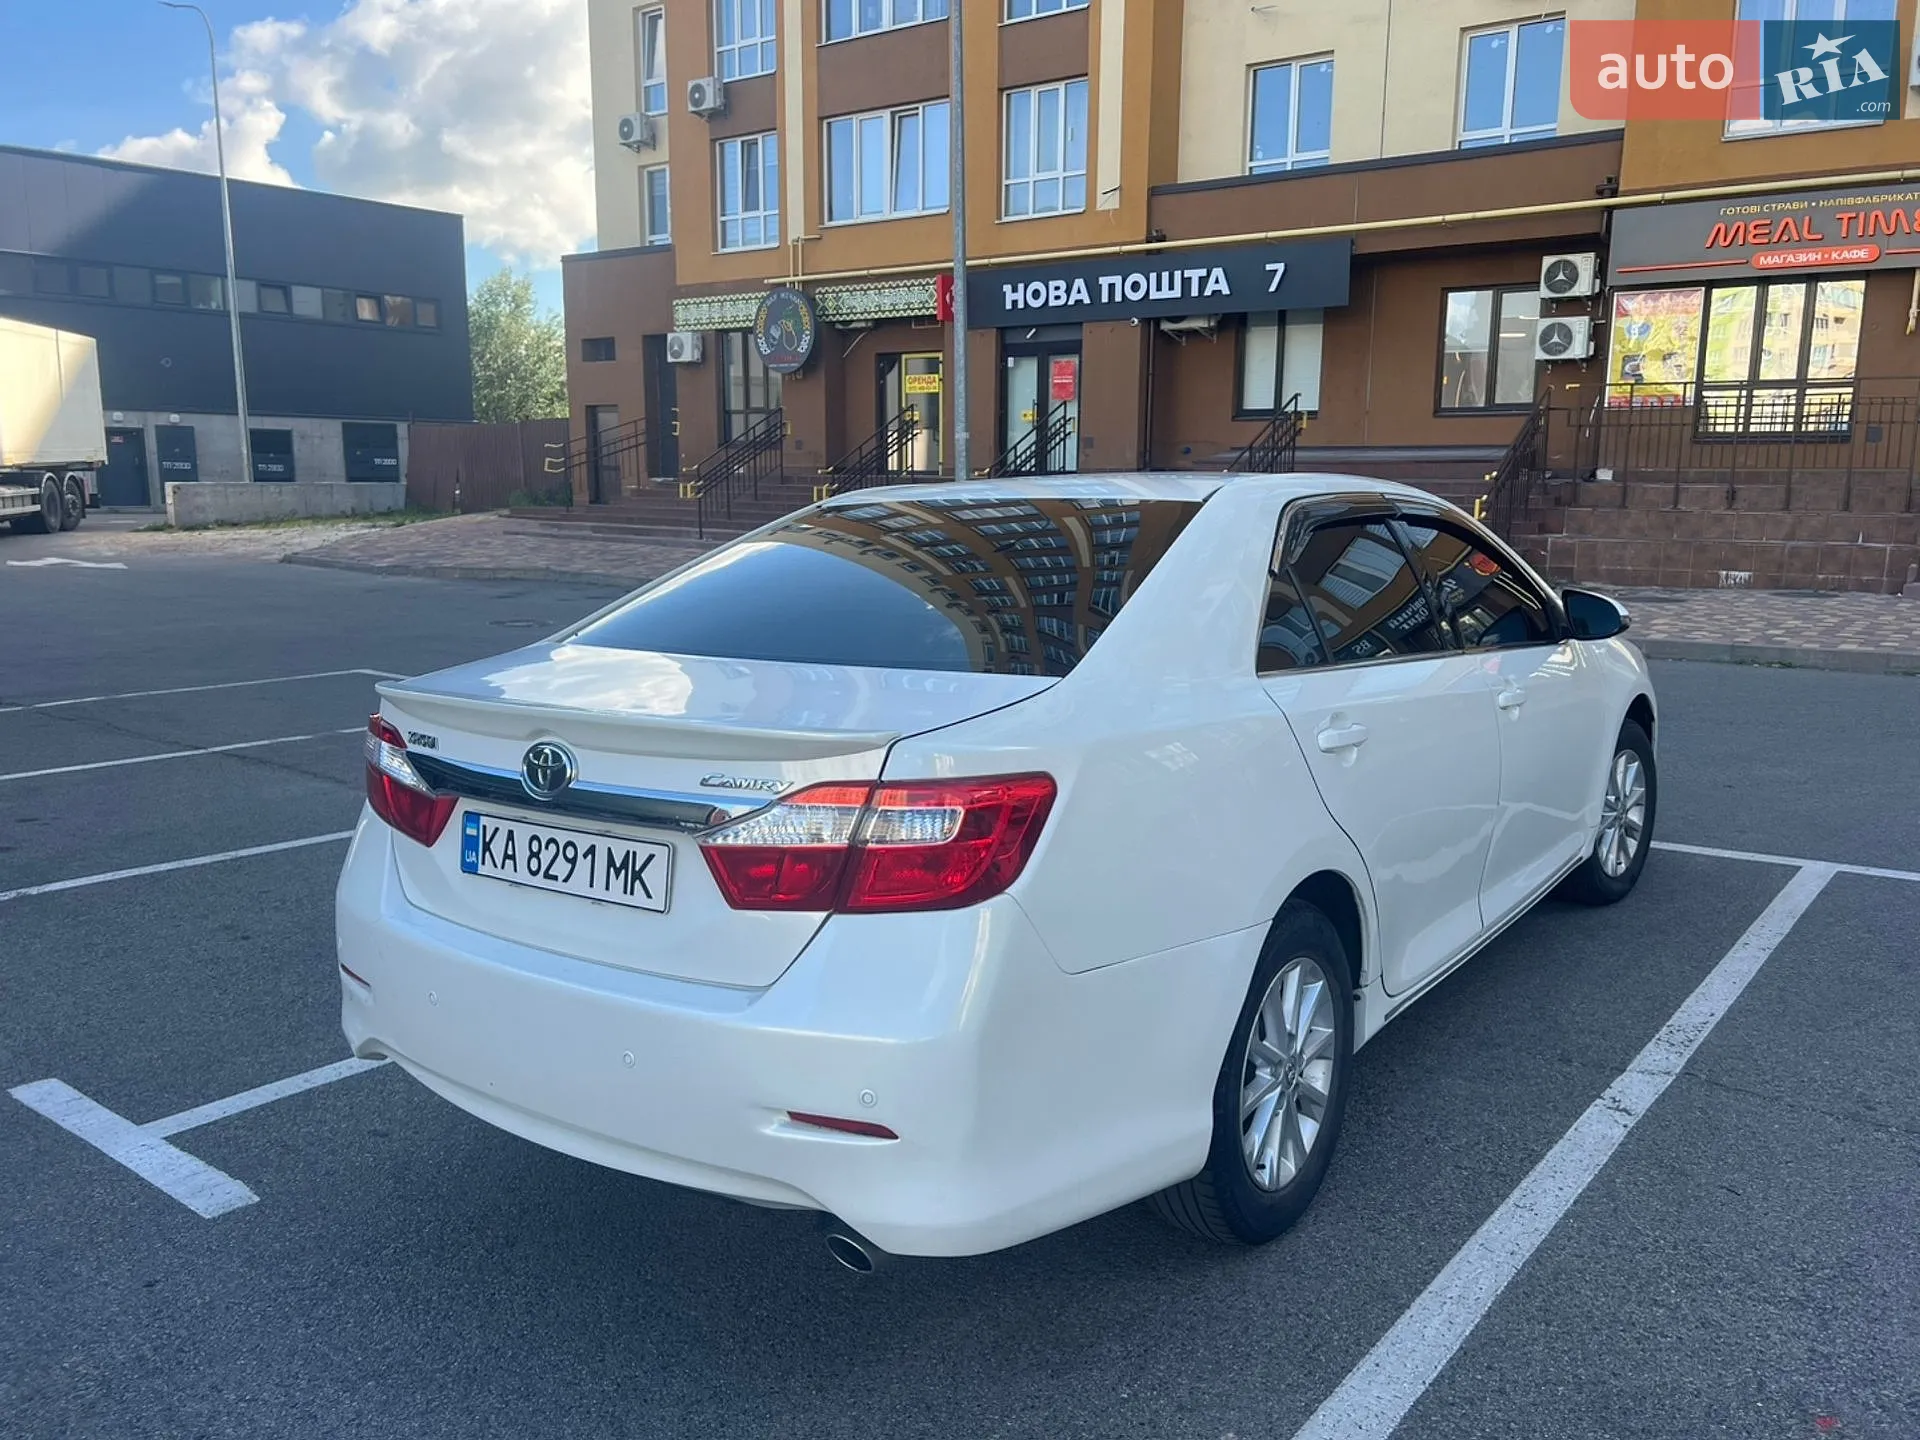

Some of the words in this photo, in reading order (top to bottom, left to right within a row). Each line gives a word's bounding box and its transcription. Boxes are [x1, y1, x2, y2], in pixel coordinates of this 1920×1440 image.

[1719, 206, 1761, 216] ГОТОВІ
[1763, 201, 1808, 213] СТРАВИ
[1705, 215, 1824, 249] MEAL
[1759, 252, 1822, 266] МАГАЗИН
[1831, 247, 1869, 261] КАФЕ
[1003, 278, 1091, 310] НОВА
[1099, 266, 1231, 304] ПОШТА
[1264, 262, 1286, 293] 7
[700, 772, 795, 795] CAMRY
[465, 850, 478, 864] UA
[481, 824, 518, 873] KA
[526, 834, 597, 888] 8291
[605, 846, 656, 899] MK
